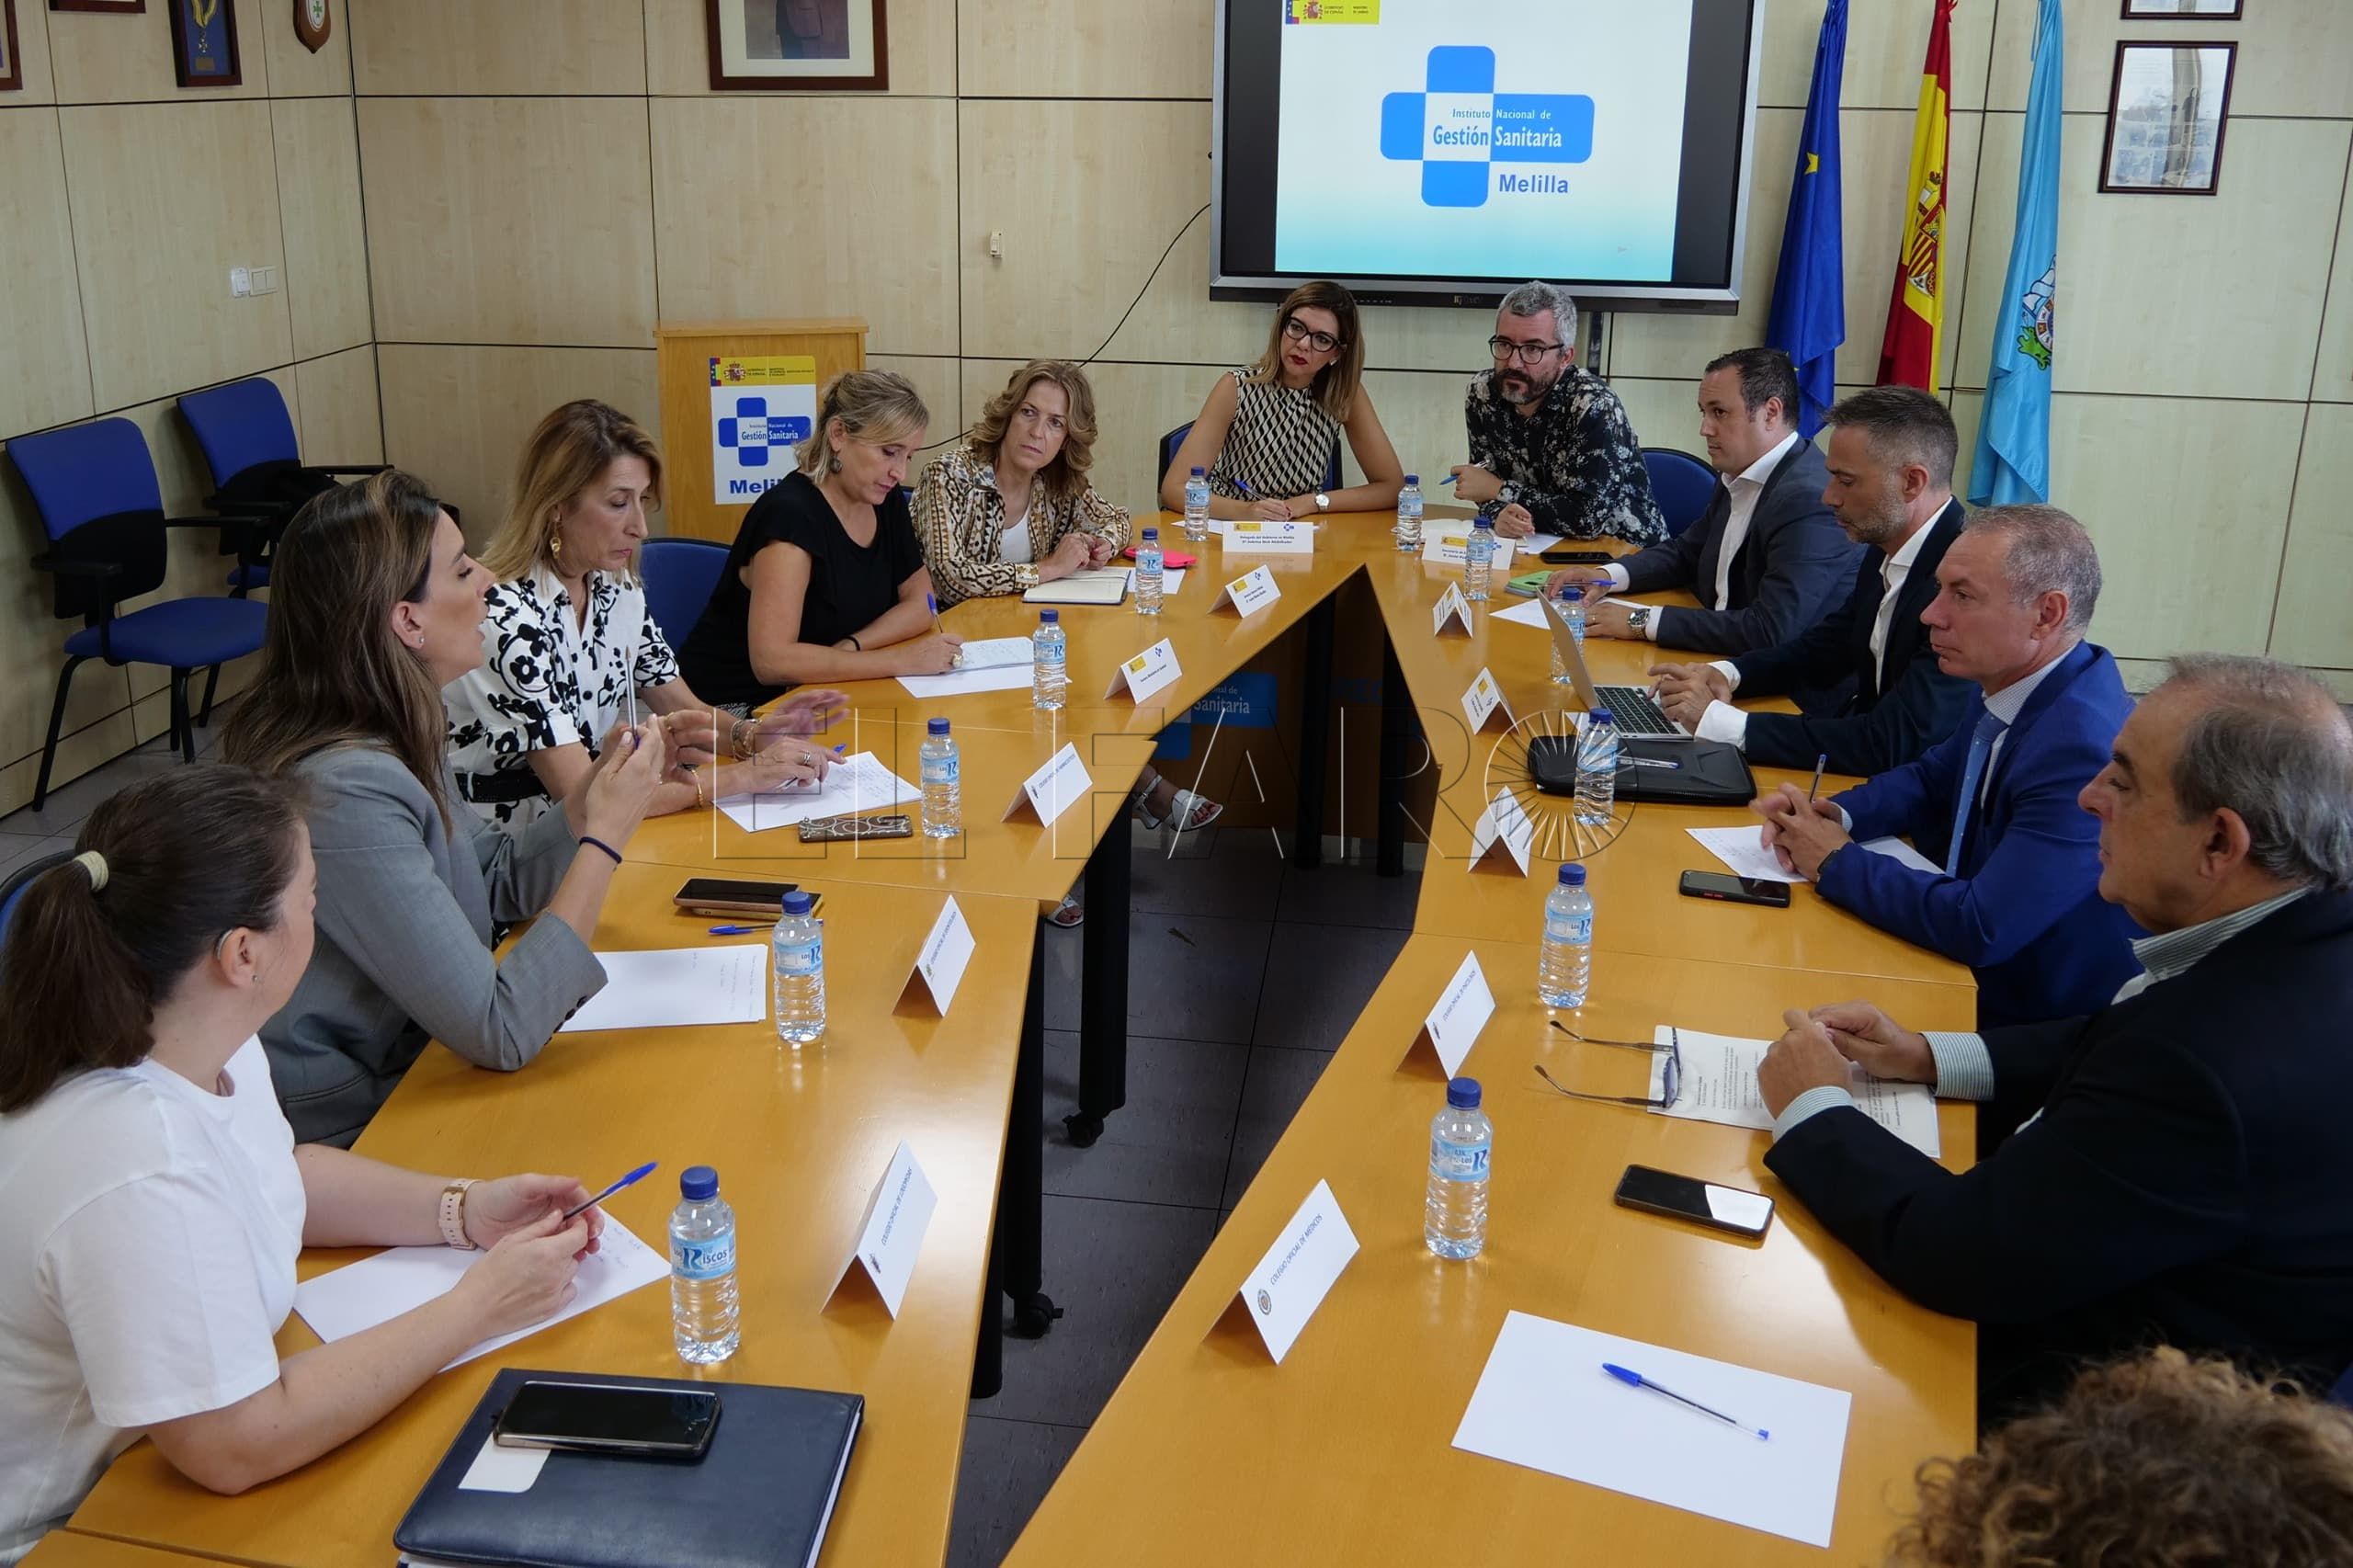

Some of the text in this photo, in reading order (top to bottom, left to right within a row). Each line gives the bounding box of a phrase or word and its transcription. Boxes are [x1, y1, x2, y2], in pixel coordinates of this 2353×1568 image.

[1452, 108, 1552, 119] Instituto Nacional de
[1433, 124, 1563, 148] Gestión Sanitaria
[1499, 174, 1569, 194] Melilla
[742, 430, 799, 440] Gestión Sanitaria
[1270, 1260, 1288, 1285] COLEGIO
